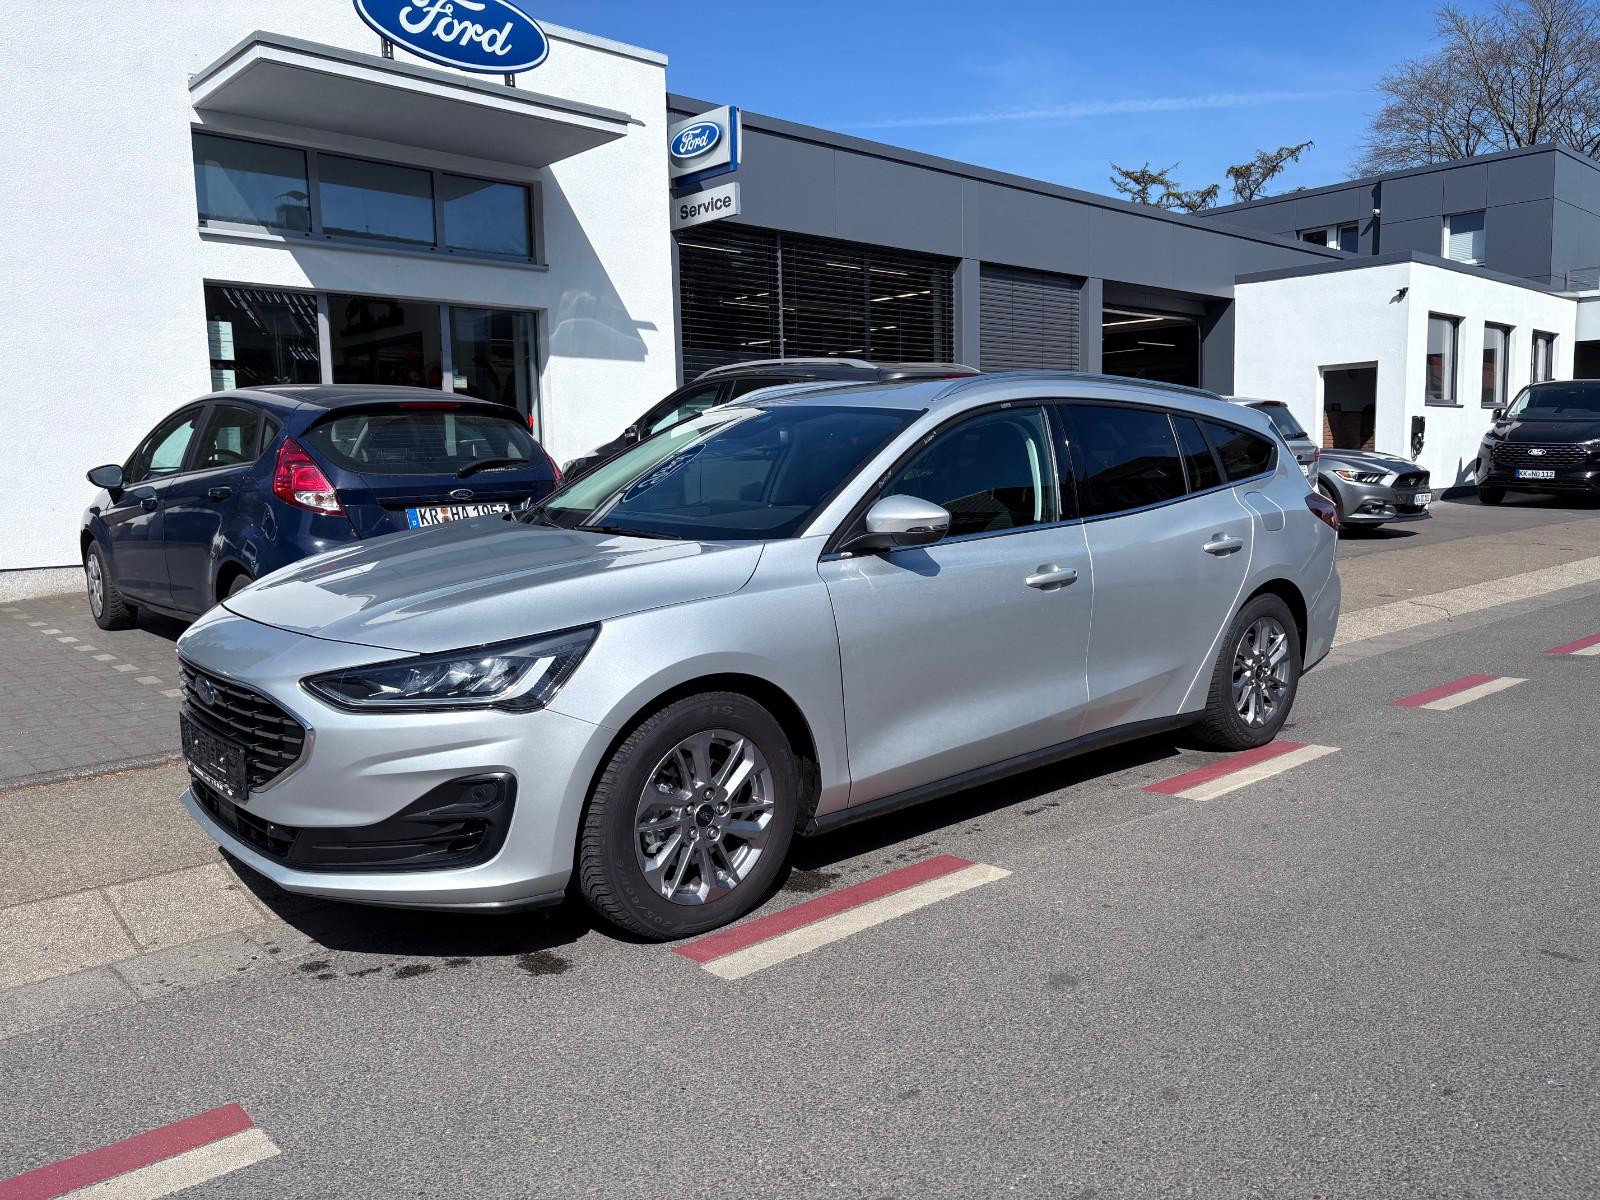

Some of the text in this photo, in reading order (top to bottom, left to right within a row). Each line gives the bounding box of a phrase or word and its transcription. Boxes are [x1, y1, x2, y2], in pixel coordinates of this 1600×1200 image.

[399, 0, 514, 56] Ford
[679, 127, 709, 153] Ford
[680, 195, 732, 220] Service
[419, 507, 441, 525] KR
[450, 505, 471, 521] HA
